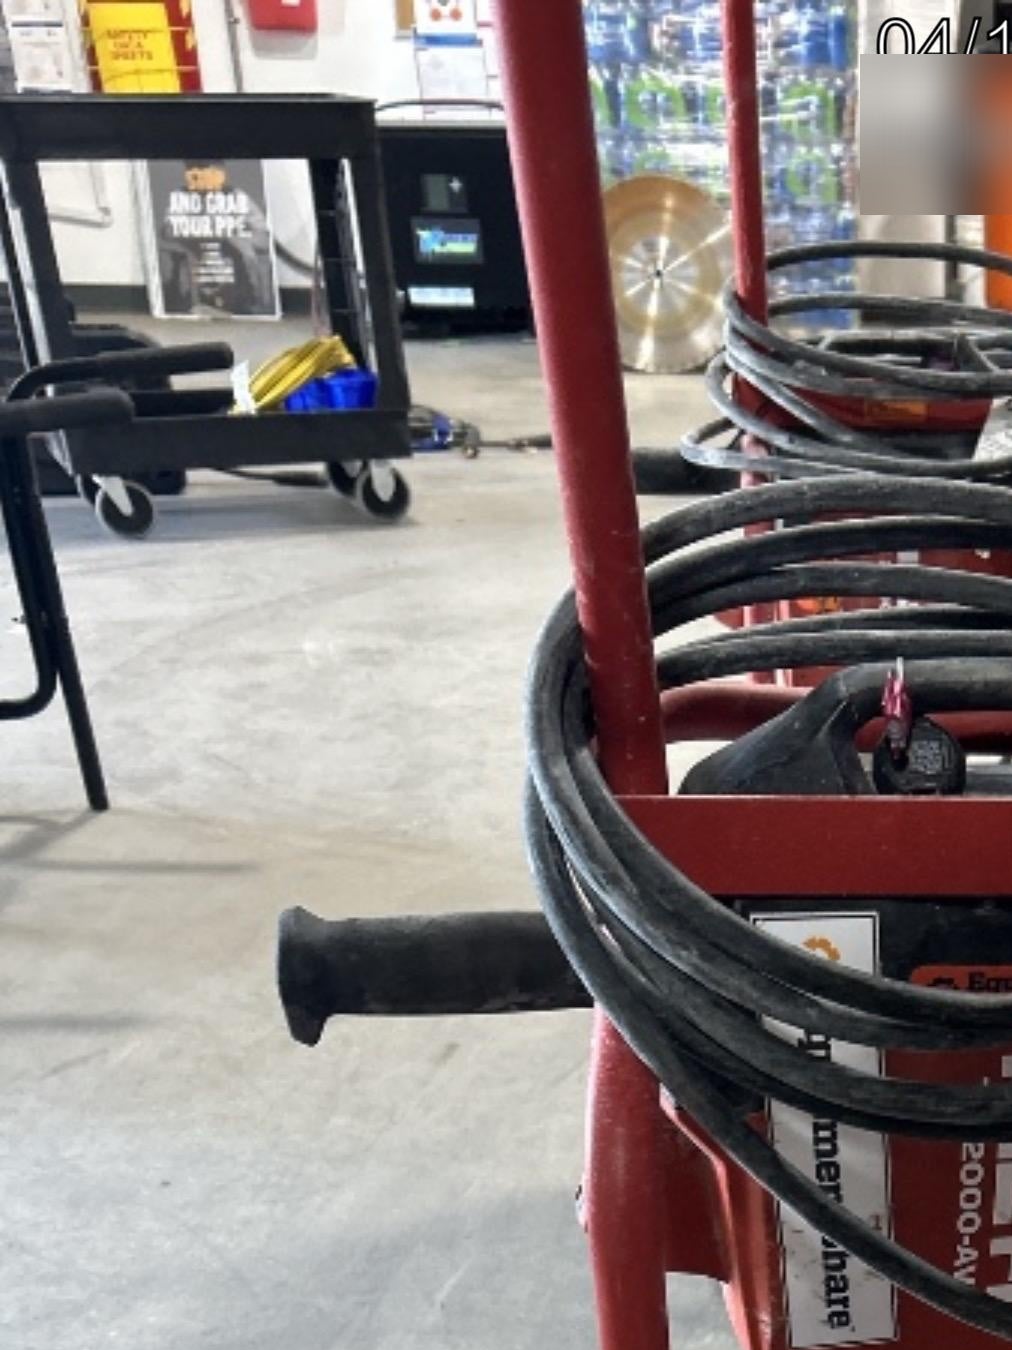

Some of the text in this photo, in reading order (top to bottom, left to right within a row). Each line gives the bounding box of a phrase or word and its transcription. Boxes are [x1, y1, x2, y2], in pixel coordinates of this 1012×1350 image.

[169, 189, 249, 214] AND GRAB
[953, 1141, 986, 1285] 2000-AV
